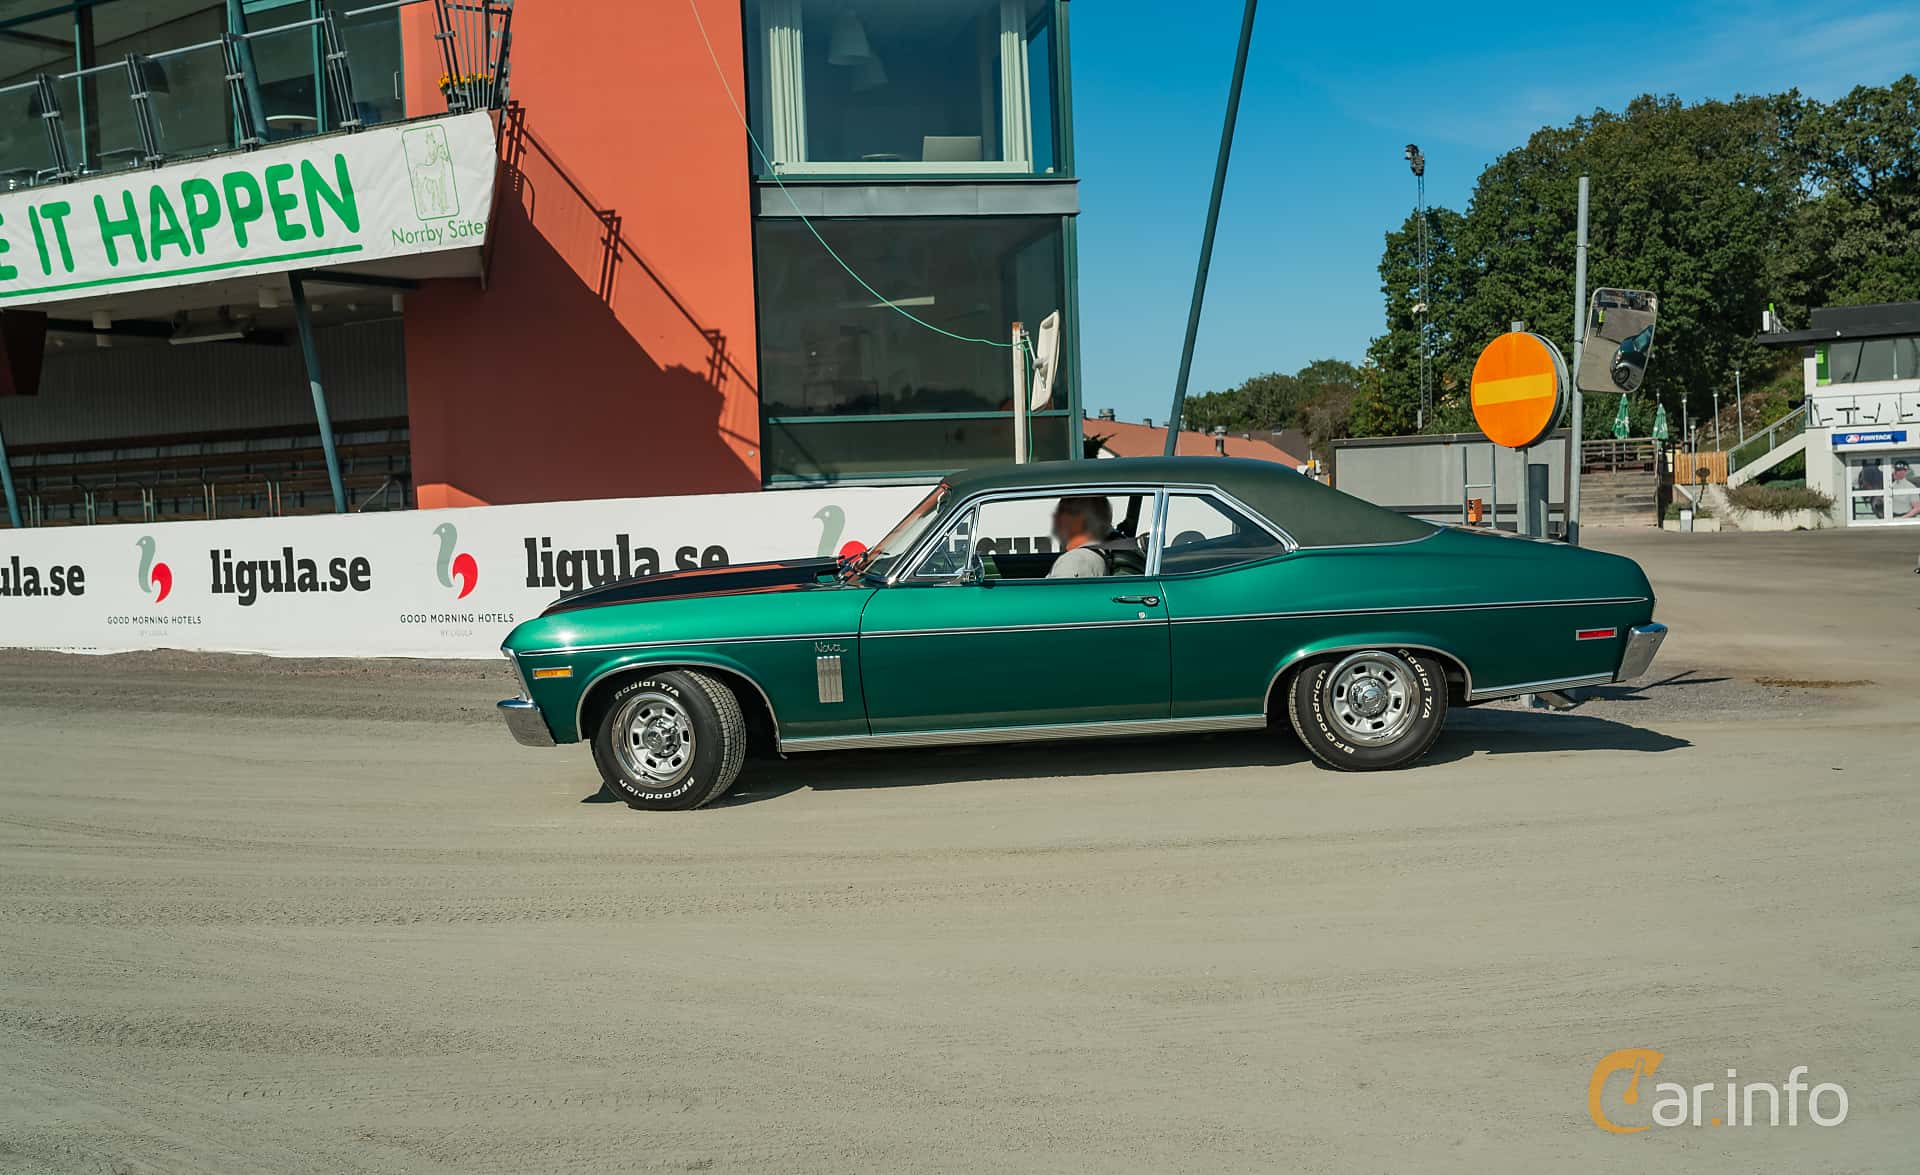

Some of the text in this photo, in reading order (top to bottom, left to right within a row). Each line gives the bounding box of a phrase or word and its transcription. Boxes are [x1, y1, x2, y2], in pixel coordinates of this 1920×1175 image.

[28, 201, 75, 276] IT
[93, 153, 361, 267] HAPPEN
[391, 223, 443, 246] Norrby
[209, 546, 371, 607] ligula.se
[107, 616, 202, 625] GOOD MORNING HOTELS
[400, 612, 514, 624] GOOD MORNING HOTELS
[815, 641, 848, 653] Nova
[1397, 648, 1432, 692] Radial
[614, 681, 681, 701] Radial T/A
[1312, 669, 1355, 754] BFGoodrich
[618, 776, 696, 800] BFGoodrich
